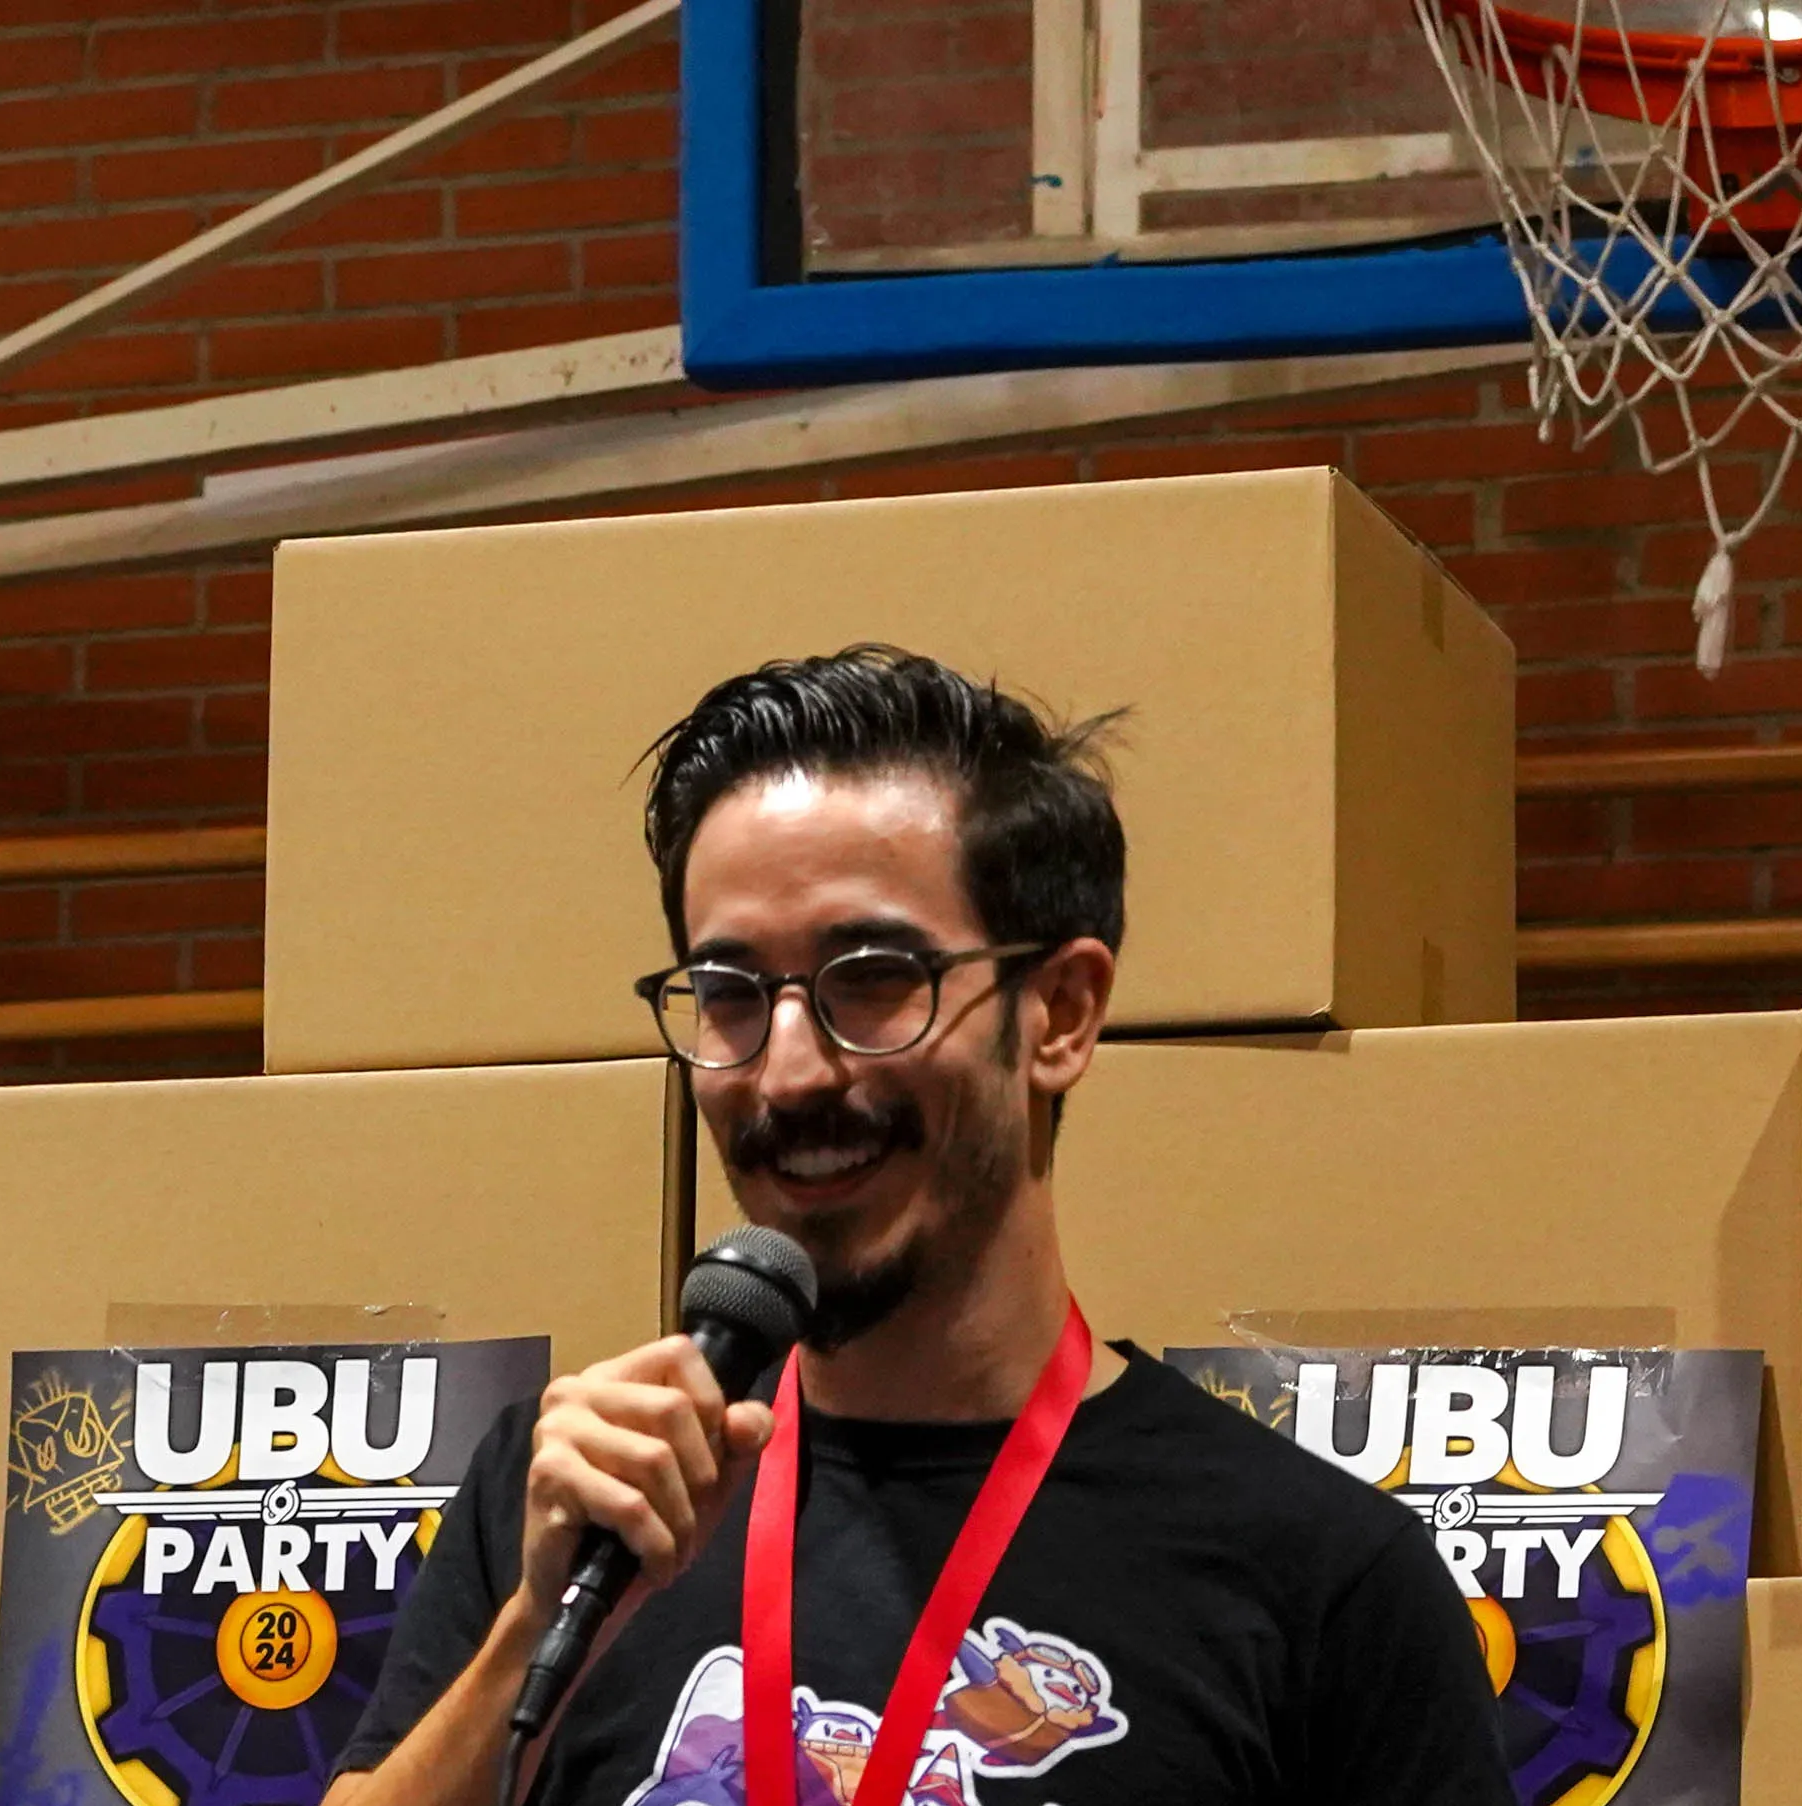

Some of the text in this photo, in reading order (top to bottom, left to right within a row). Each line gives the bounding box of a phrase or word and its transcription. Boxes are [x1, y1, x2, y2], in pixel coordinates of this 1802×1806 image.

[134, 1357, 438, 1485] UBU
[1295, 1363, 1629, 1488] UBU
[143, 1521, 419, 1595] PARTY
[1435, 1528, 1607, 1599] RTY
[255, 1641, 296, 1671] 24
[256, 1611, 297, 1640] 20
